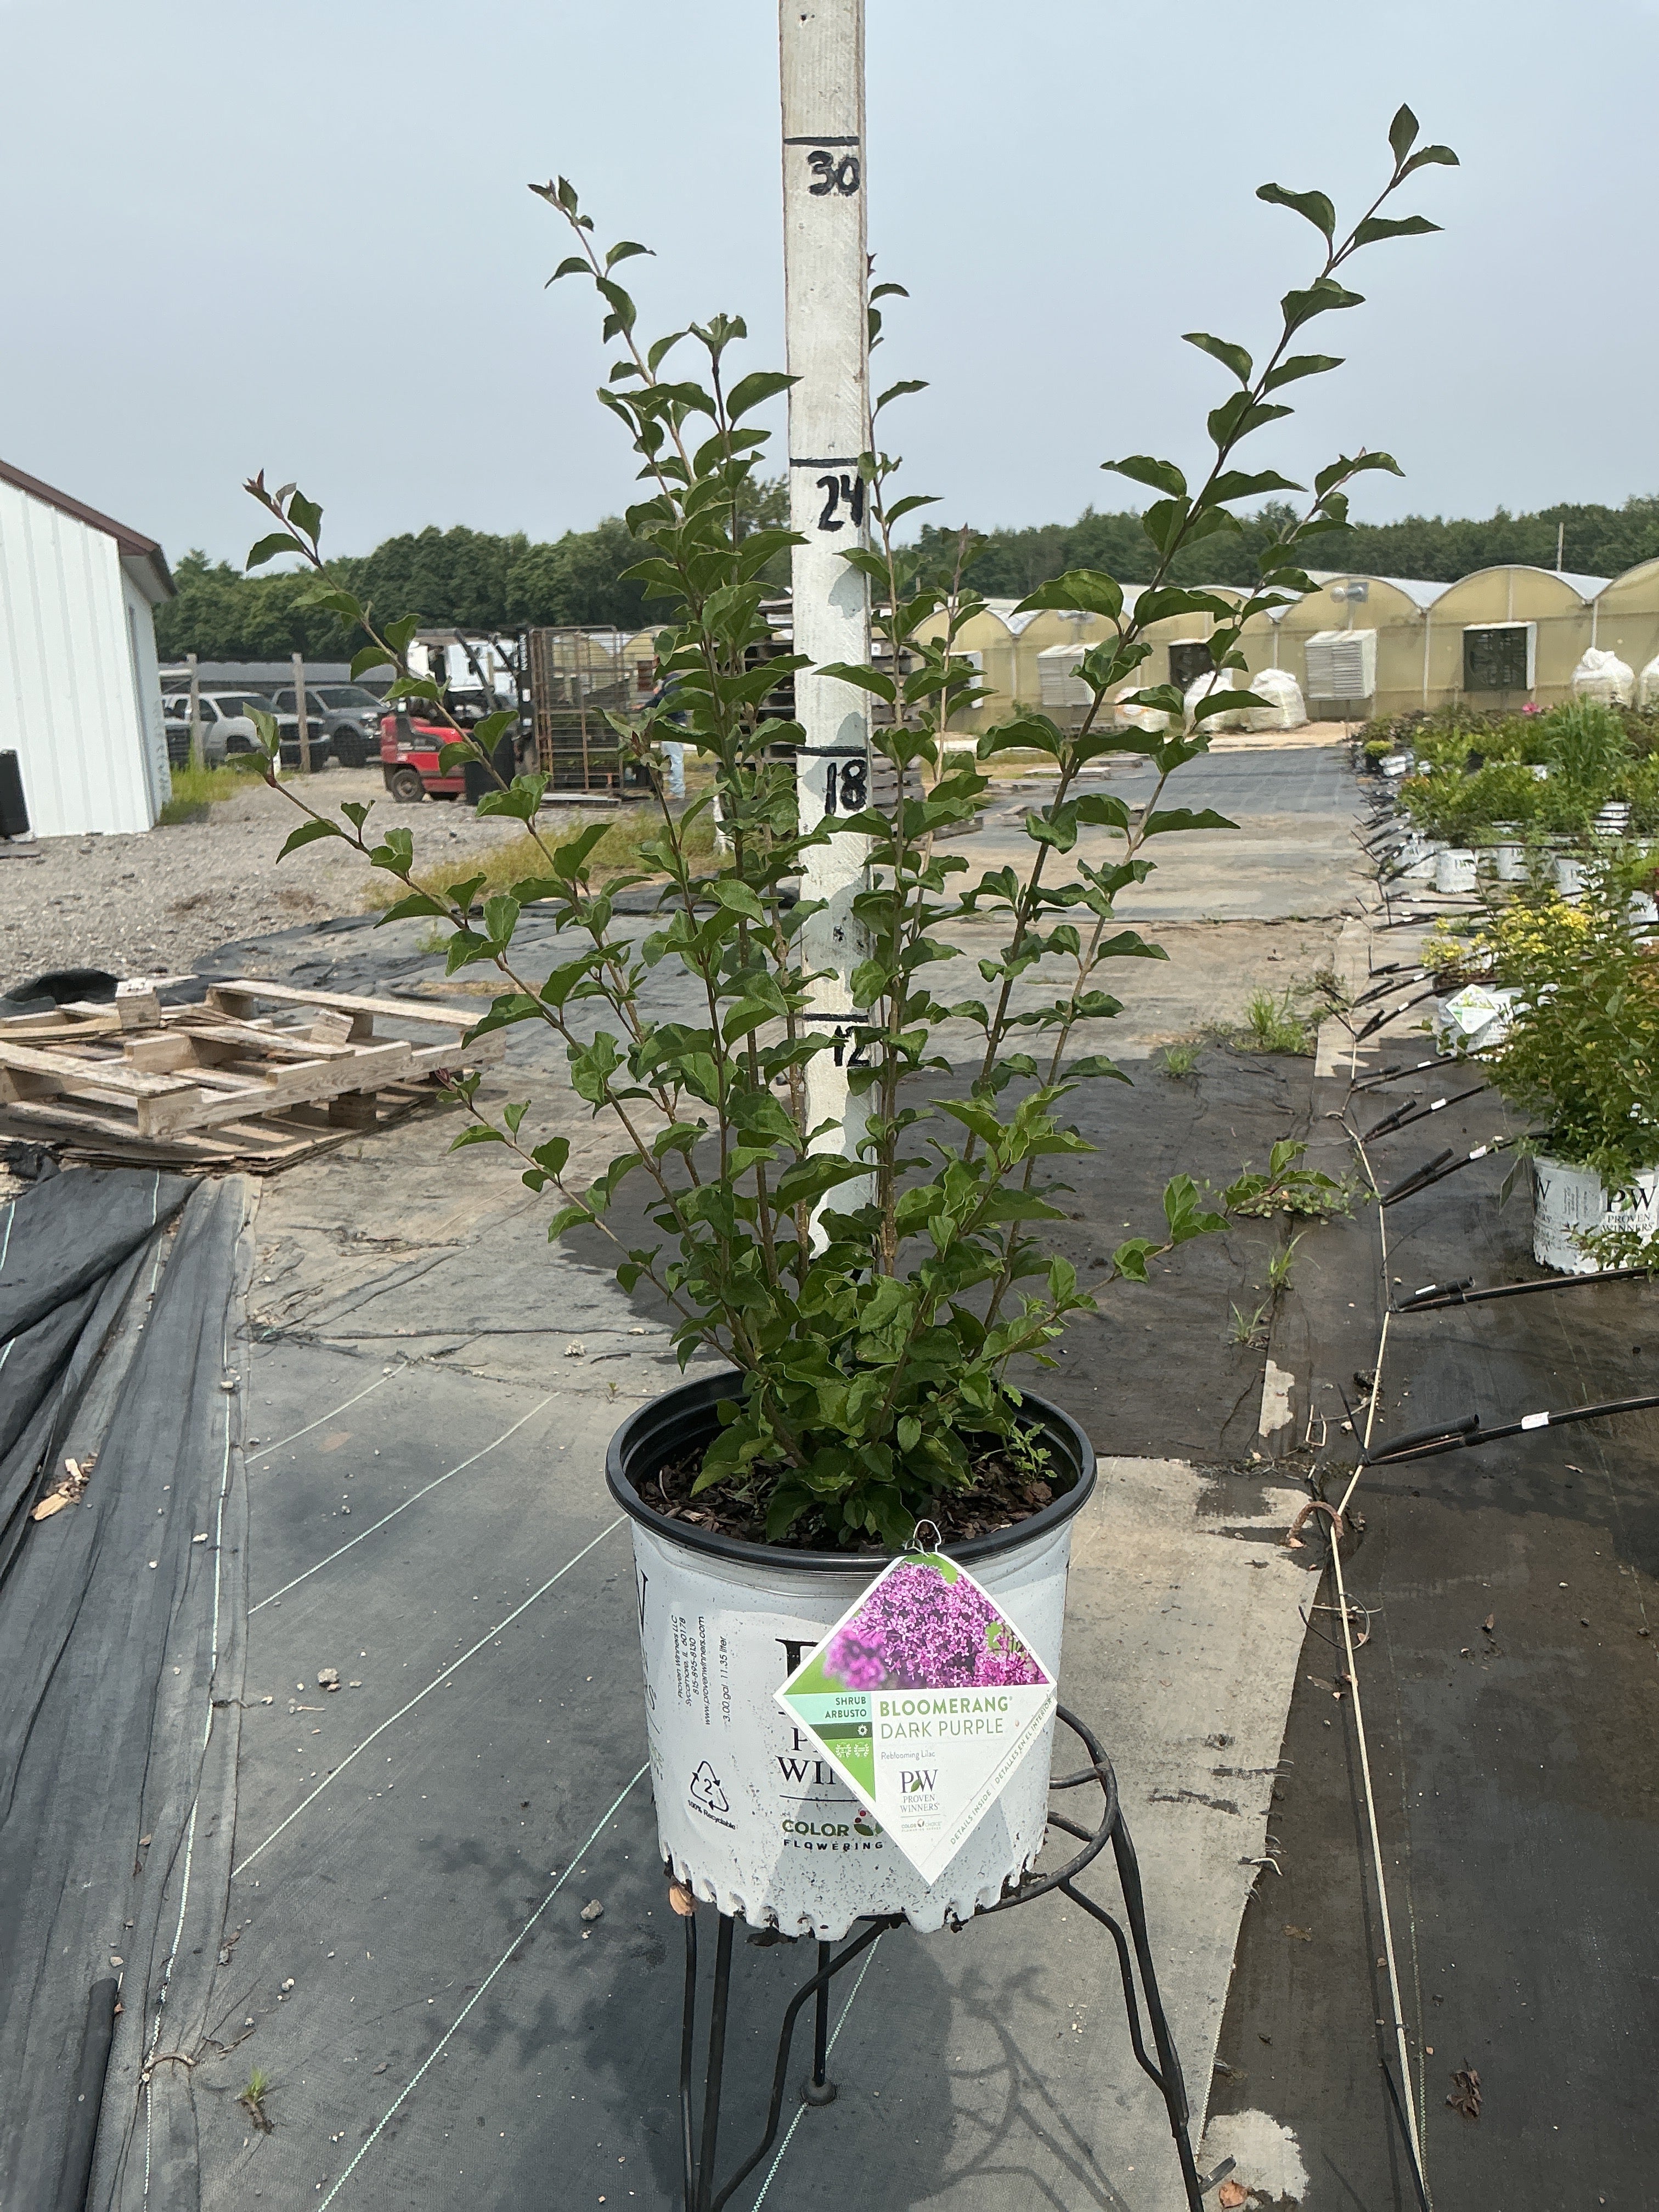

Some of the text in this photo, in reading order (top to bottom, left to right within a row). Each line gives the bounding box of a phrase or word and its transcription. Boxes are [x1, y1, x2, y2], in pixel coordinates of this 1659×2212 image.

[808, 150, 860, 196] 30
[816, 475, 864, 532] 24
[825, 759, 867, 815] 18
[834, 1025, 870, 1067] 12
[679, 1617, 687, 1646] 60178
[673, 1633, 681, 1667] Winners
[689, 1637, 699, 1695] 815-895-8130
[698, 1616, 710, 1725] www.provenwinners.com
[719, 1636, 731, 1722] 3.00 gal 11.35 liter
[825, 1709, 867, 1719] ARBUSTO
[836, 1696, 867, 1706] SHRUB
[881, 1718, 1003, 1740] DARK PURPLE
[881, 1751, 919, 1760] Reblooming
[899, 1769, 939, 1793] PW
[950, 1697, 1052, 1845] DETAILS INSIDE DETALLES EN EL INTERIOR
[704, 1778, 713, 1796] 2
[903, 1794, 935, 1804] PROVEN
[687, 1799, 736, 1830] 100% Recyclable
[782, 1819, 849, 1837] COLOR
[783, 1838, 883, 1852] FLOWERING
